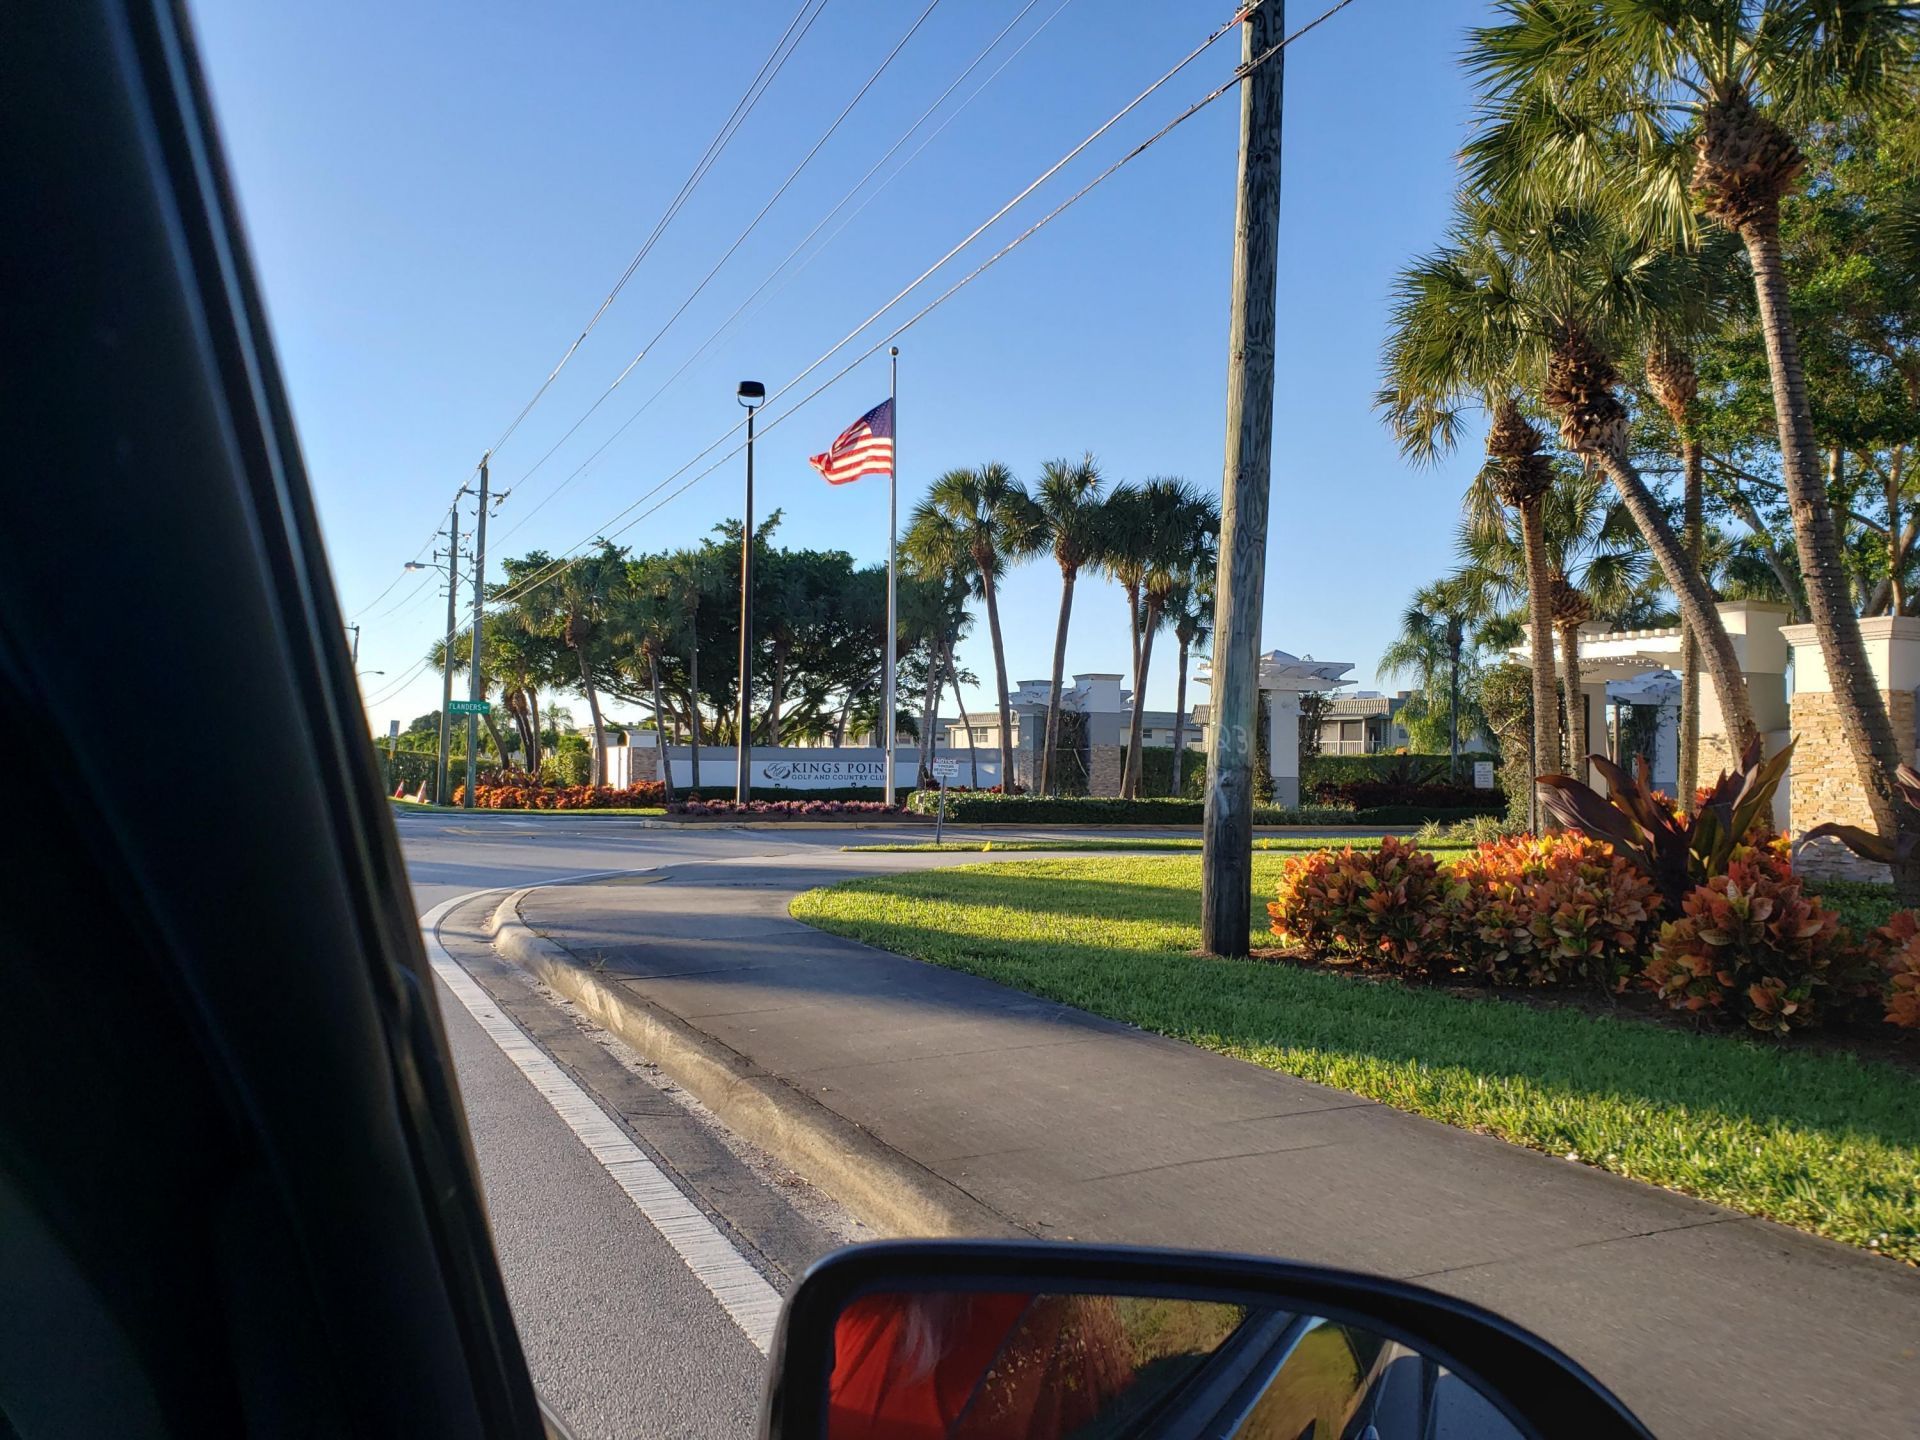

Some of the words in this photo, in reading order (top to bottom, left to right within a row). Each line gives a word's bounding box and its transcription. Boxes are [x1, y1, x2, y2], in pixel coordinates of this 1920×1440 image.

[448, 702, 482, 710] FLANDERS
[792, 762, 840, 774] KINGS
[847, 762, 885, 774] POIN
